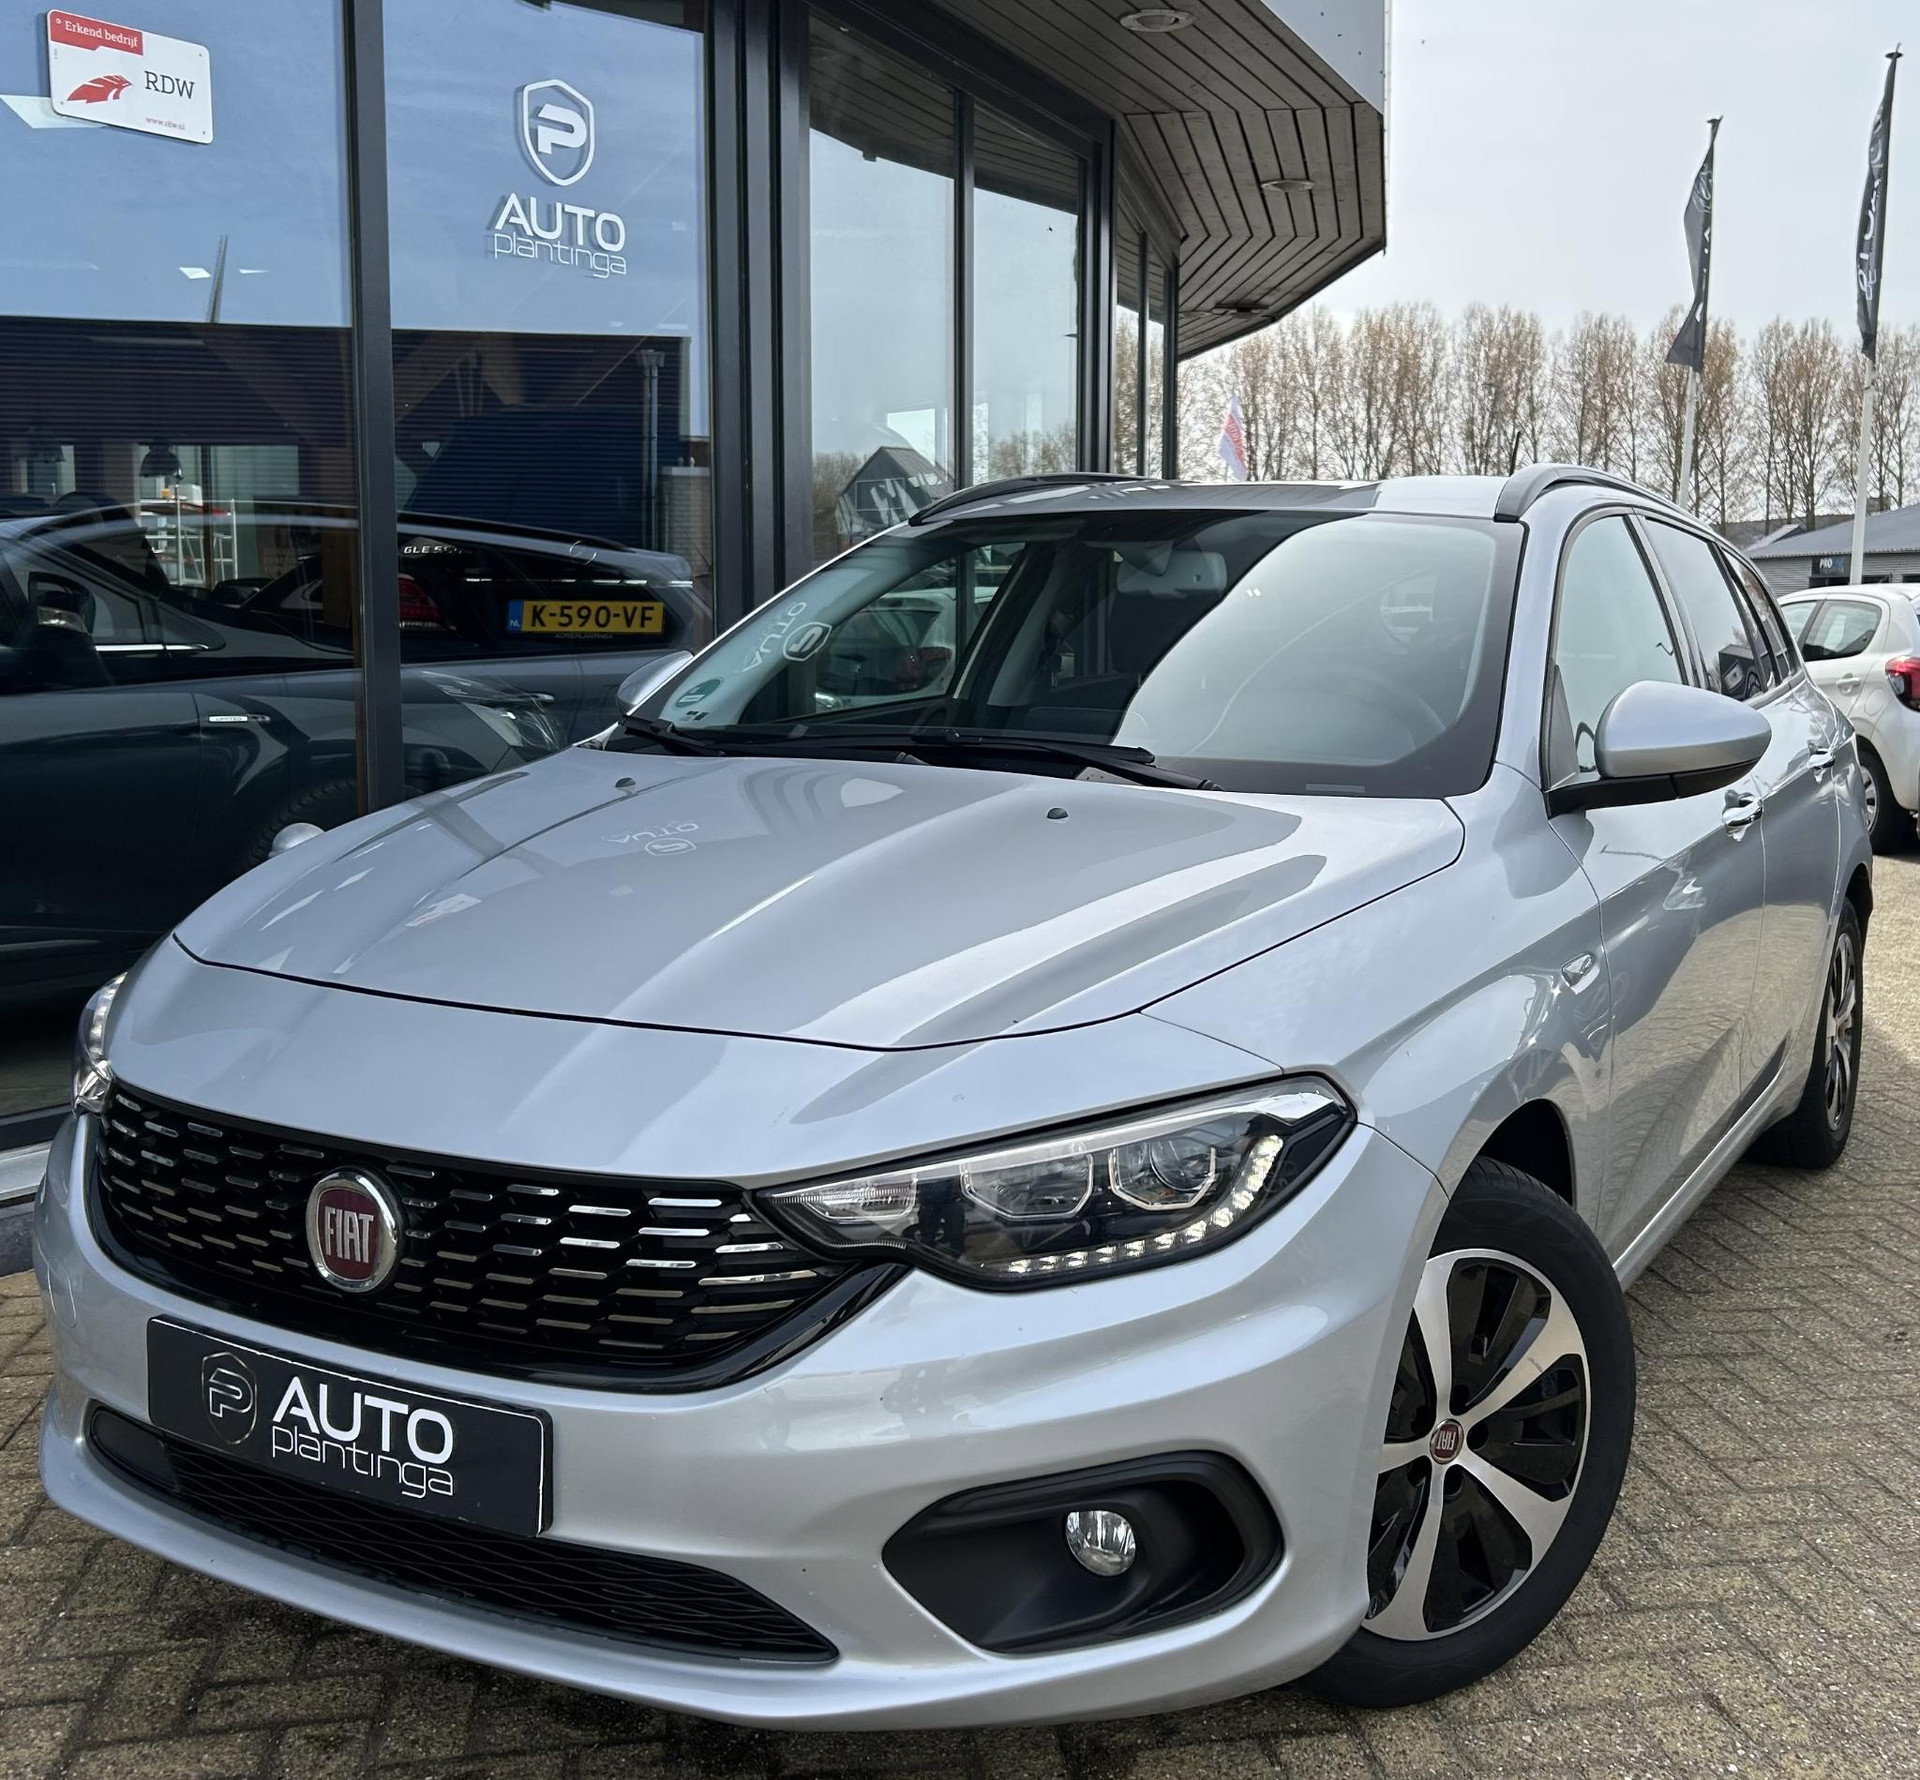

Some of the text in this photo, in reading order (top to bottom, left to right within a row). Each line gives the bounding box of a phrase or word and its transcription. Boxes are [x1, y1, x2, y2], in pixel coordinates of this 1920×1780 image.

[64, 20, 138, 48] Erkend bedrijf
[144, 70, 195, 99] RDW
[494, 192, 626, 252] AUTO
[494, 231, 627, 279] plantinga
[531, 604, 655, 628] K-590-VF
[324, 1206, 374, 1264] FIAT
[272, 1376, 454, 1465] AUTO
[1435, 1430, 1457, 1451] FIAT
[272, 1425, 454, 1499] plantinga
